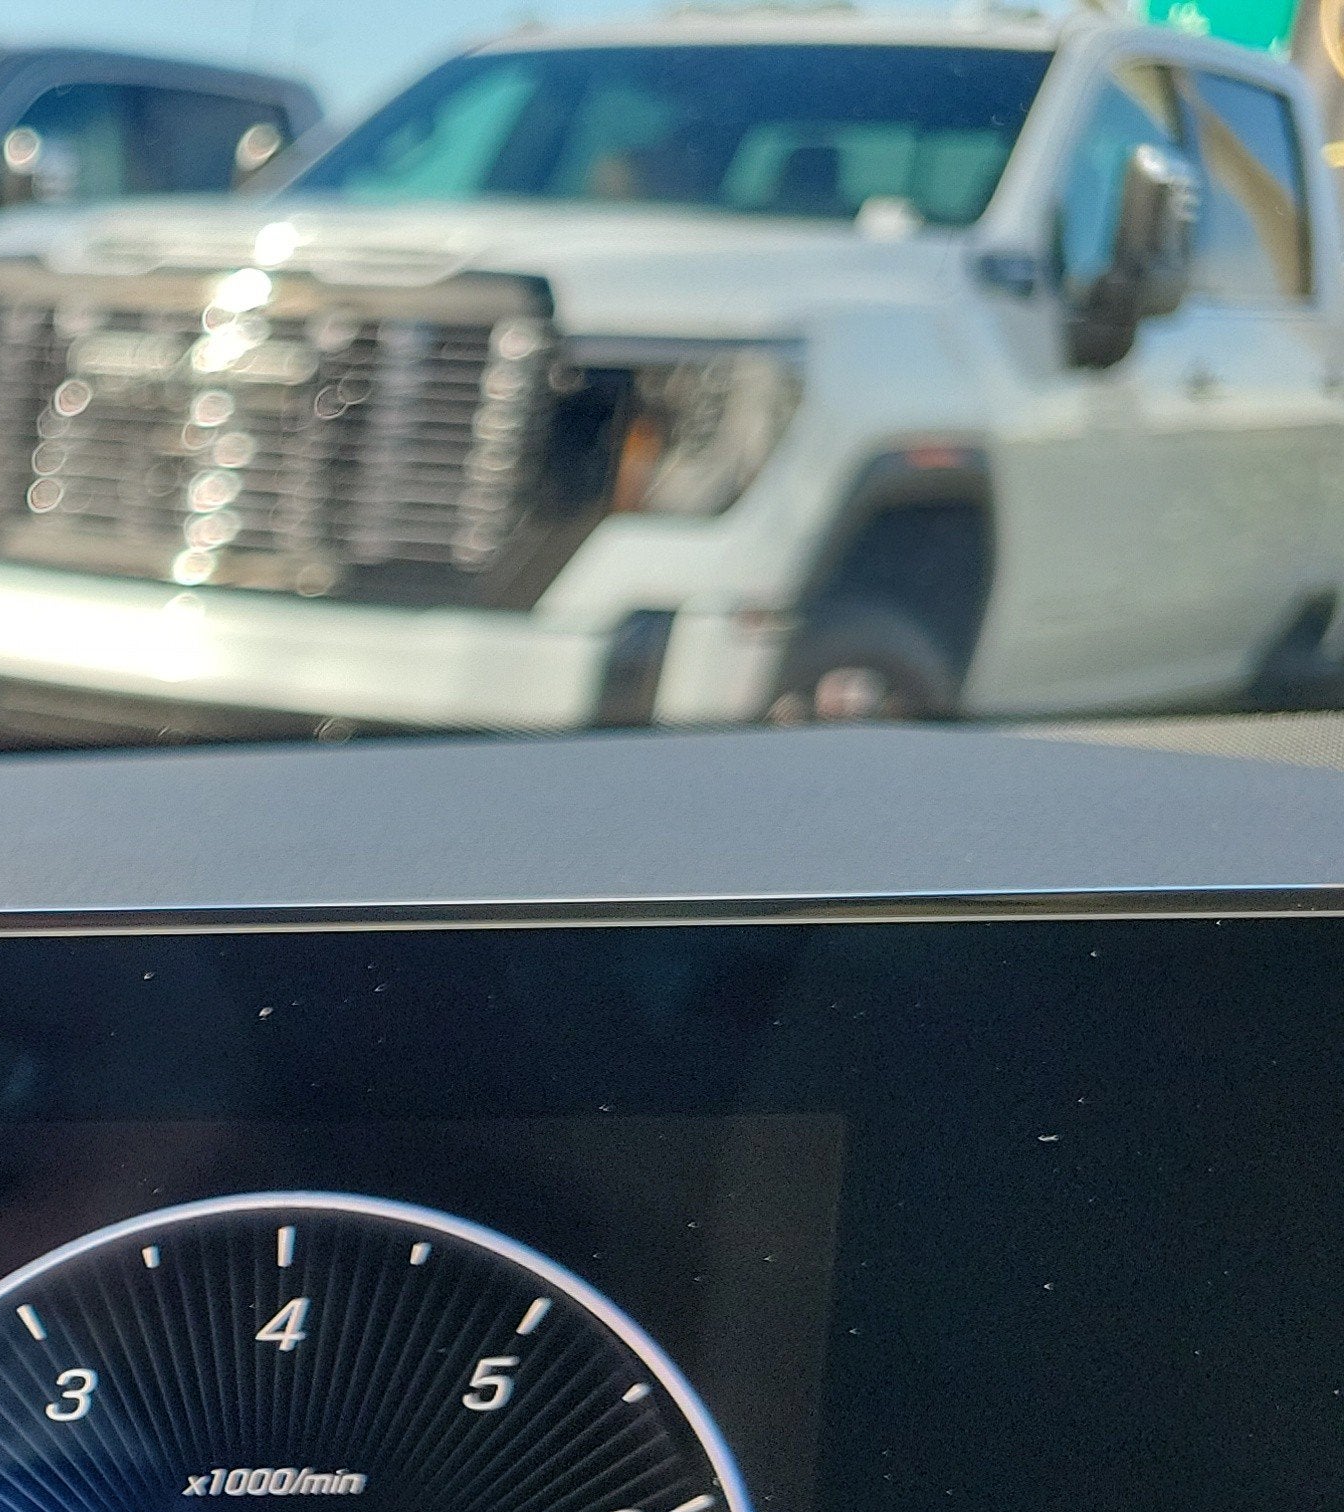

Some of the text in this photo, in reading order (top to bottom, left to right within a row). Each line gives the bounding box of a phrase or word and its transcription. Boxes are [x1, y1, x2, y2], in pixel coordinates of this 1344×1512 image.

[254, 1297, 309, 1352] 4
[45, 1368, 96, 1422] 3
[462, 1356, 517, 1411] 5
[182, 1467, 366, 1496] x1000/min
